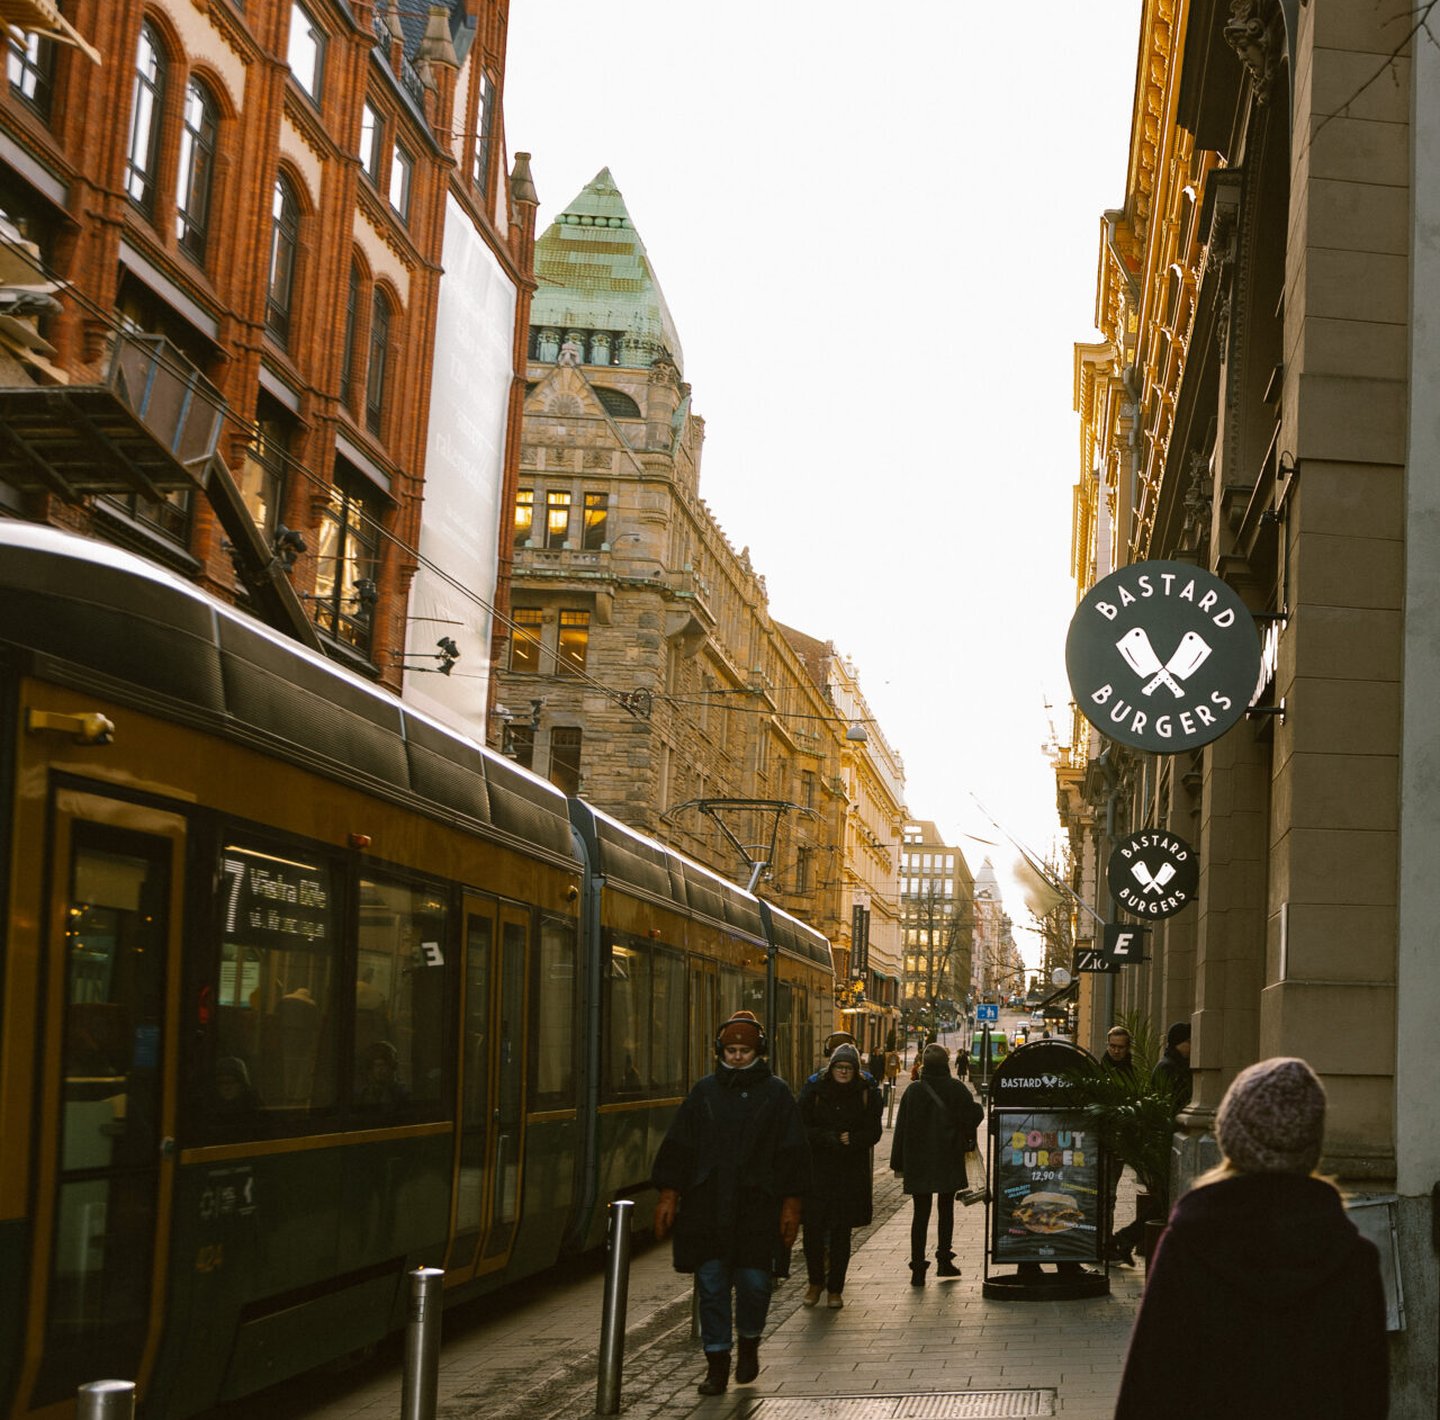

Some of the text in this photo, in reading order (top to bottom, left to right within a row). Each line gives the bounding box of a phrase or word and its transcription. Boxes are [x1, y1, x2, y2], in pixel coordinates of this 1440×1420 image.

[1095, 573, 1235, 627] BASTARD
[1091, 684, 1232, 738] BURGERS
[1121, 835, 1188, 861] BASTARD
[224, 858, 245, 933] 7
[1119, 887, 1186, 914] BURGERS
[1113, 933, 1135, 955] E
[1001, 1078, 1042, 1088] BASTARD
[1011, 1130, 1086, 1149] DONUT
[1011, 1150, 1086, 1168] BURGER
